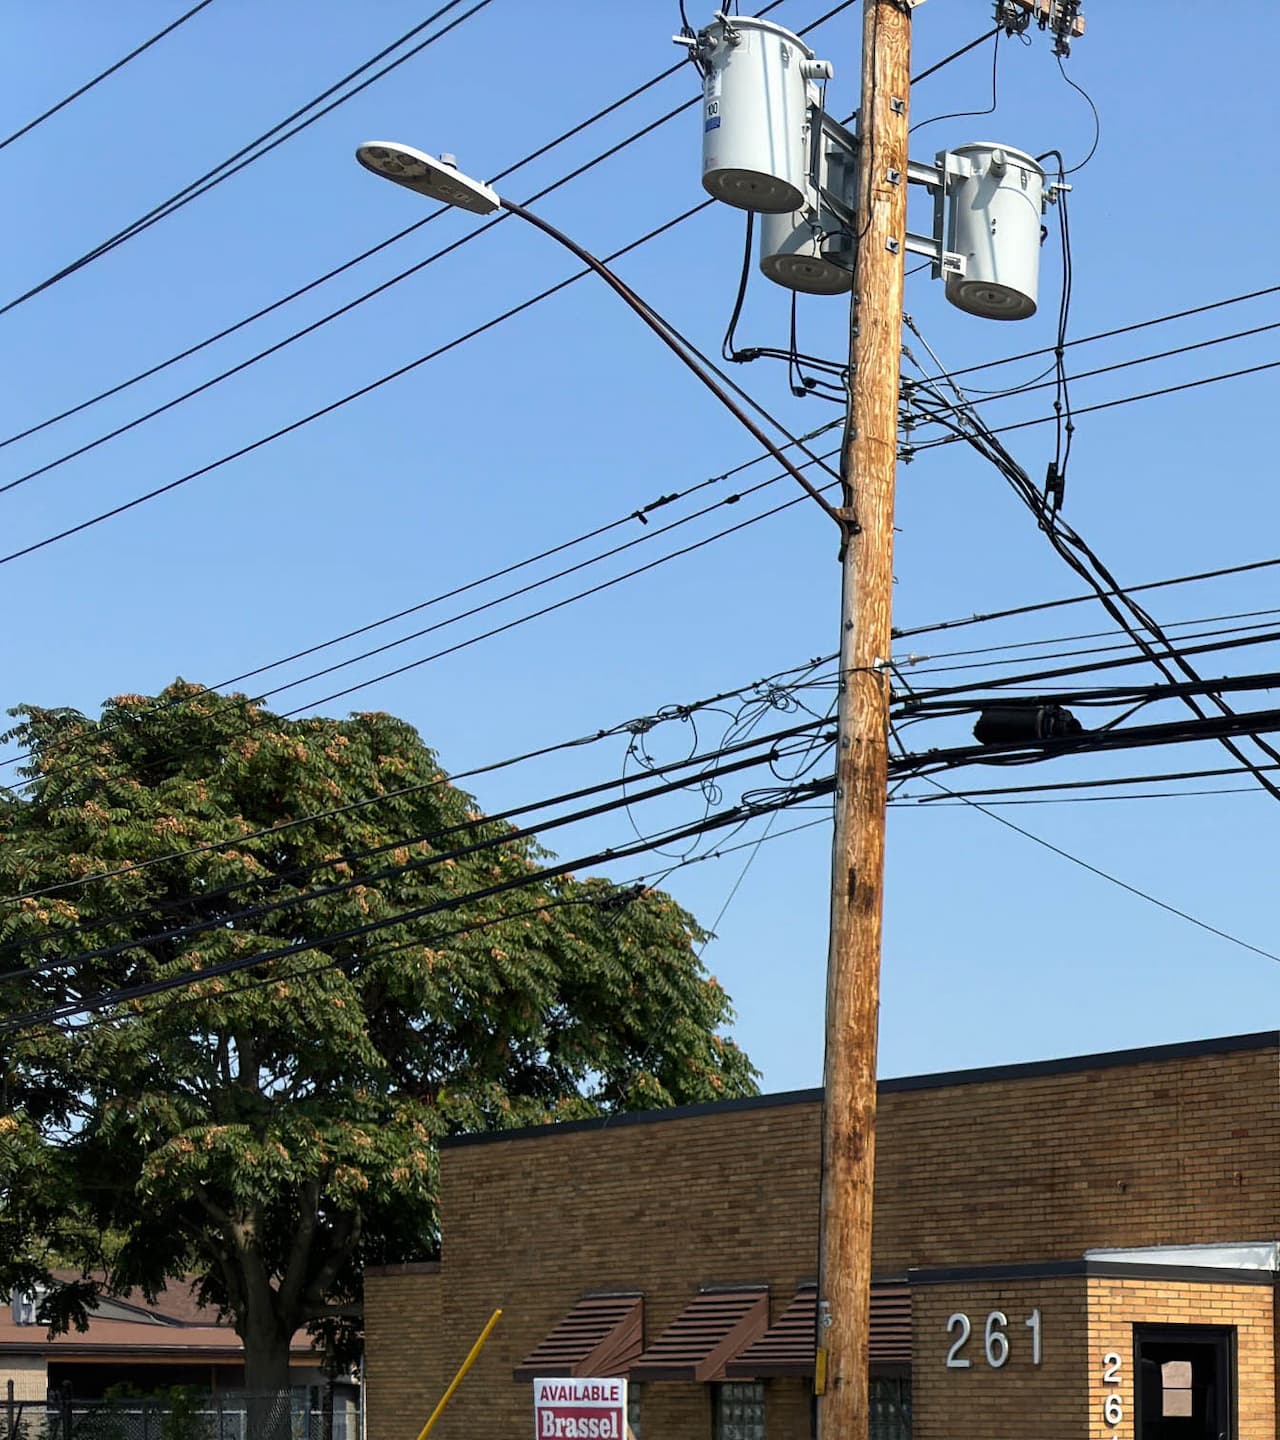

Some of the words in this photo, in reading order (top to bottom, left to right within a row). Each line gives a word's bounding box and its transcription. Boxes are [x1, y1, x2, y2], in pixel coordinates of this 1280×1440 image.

[946, 1309, 1042, 1368] 261
[540, 1385, 619, 1401] AVAILABLE
[541, 1410, 618, 1438] Brassel
